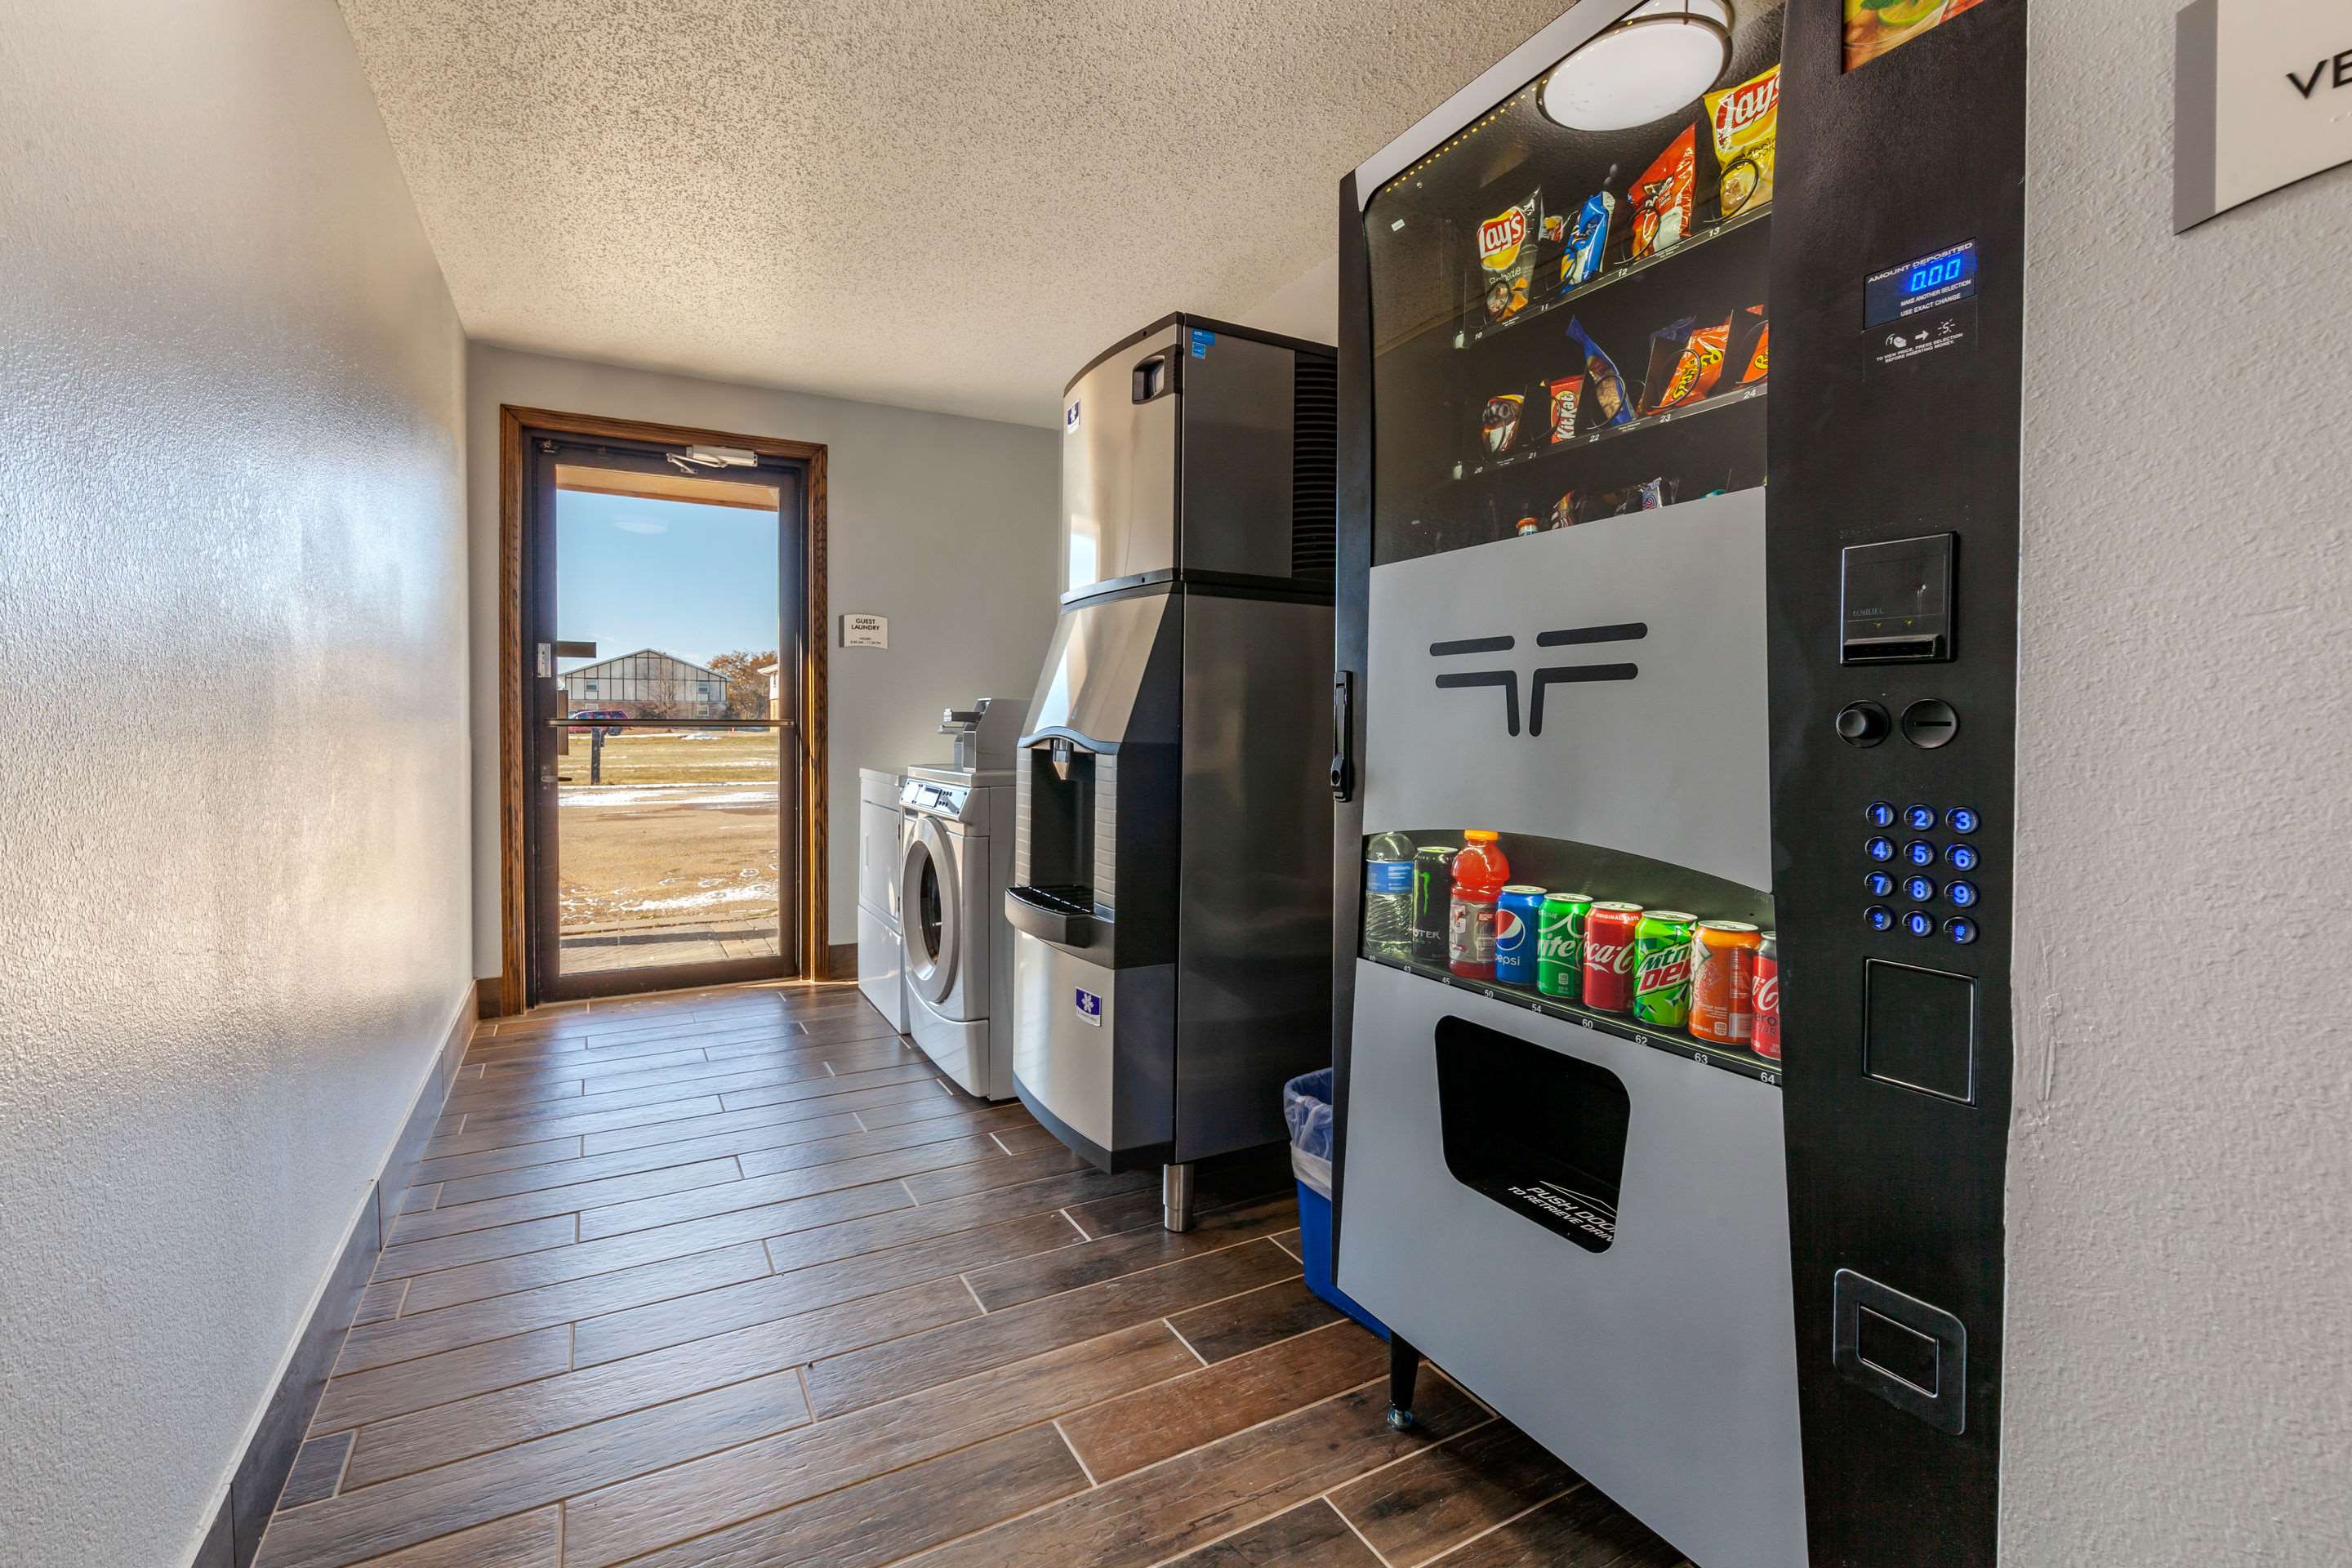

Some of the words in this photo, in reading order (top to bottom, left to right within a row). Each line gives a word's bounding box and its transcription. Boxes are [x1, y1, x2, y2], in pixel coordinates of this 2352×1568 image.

[1479, 216, 1521, 259] Lay's
[1708, 228, 1720, 237] 13
[1868, 264, 1911, 284] AMOUNT
[1913, 243, 1973, 268] DEPOSITED
[1618, 268, 1628, 277] 12
[1910, 258, 1962, 292] 0.00
[1900, 297, 1916, 307] MAKE
[1915, 289, 1941, 302] ANOTHER
[1940, 279, 1971, 295] SELECTION
[1541, 303, 1549, 311] 11
[1900, 307, 1913, 317] USE
[1913, 301, 1934, 314] EXACT
[1935, 292, 1961, 305] CHANGE
[1915, 341, 1932, 350] PRESS
[1933, 332, 1963, 345] SELECTION
[1885, 354, 1905, 363] BEFORE
[1906, 345, 1933, 357] INSERTING
[1744, 390, 1756, 399] 24
[1659, 414, 1671, 423] 23
[1589, 434, 1600, 442] 22
[1528, 451, 1537, 459] 21
[1875, 807, 1885, 823] 1
[1913, 810, 1927, 826] 2
[1955, 811, 1970, 830] 3
[1873, 841, 1885, 858] 4
[1913, 845, 1926, 863] 5
[1953, 849, 1970, 868] 6
[1873, 875, 1885, 893] 7
[1913, 880, 1926, 898] 8
[1953, 886, 1969, 904] 9
[1595, 912, 1622, 920] ORIGINAL
[1912, 916, 1924, 933] 0
[1403, 965, 1411, 973] 43
[1441, 977, 1450, 985] 45
[1484, 989, 1494, 999] 50
[1531, 1004, 1542, 1013] 54
[1582, 1019, 1593, 1028] 60
[1635, 1034, 1647, 1046] 62
[1694, 1053, 1708, 1065] 63
[1760, 1072, 1775, 1085] 64
[1508, 1186, 1528, 1196] TO
[1523, 1194, 1583, 1225] RETRIEVE
[1526, 1187, 1579, 1211] PUSH
